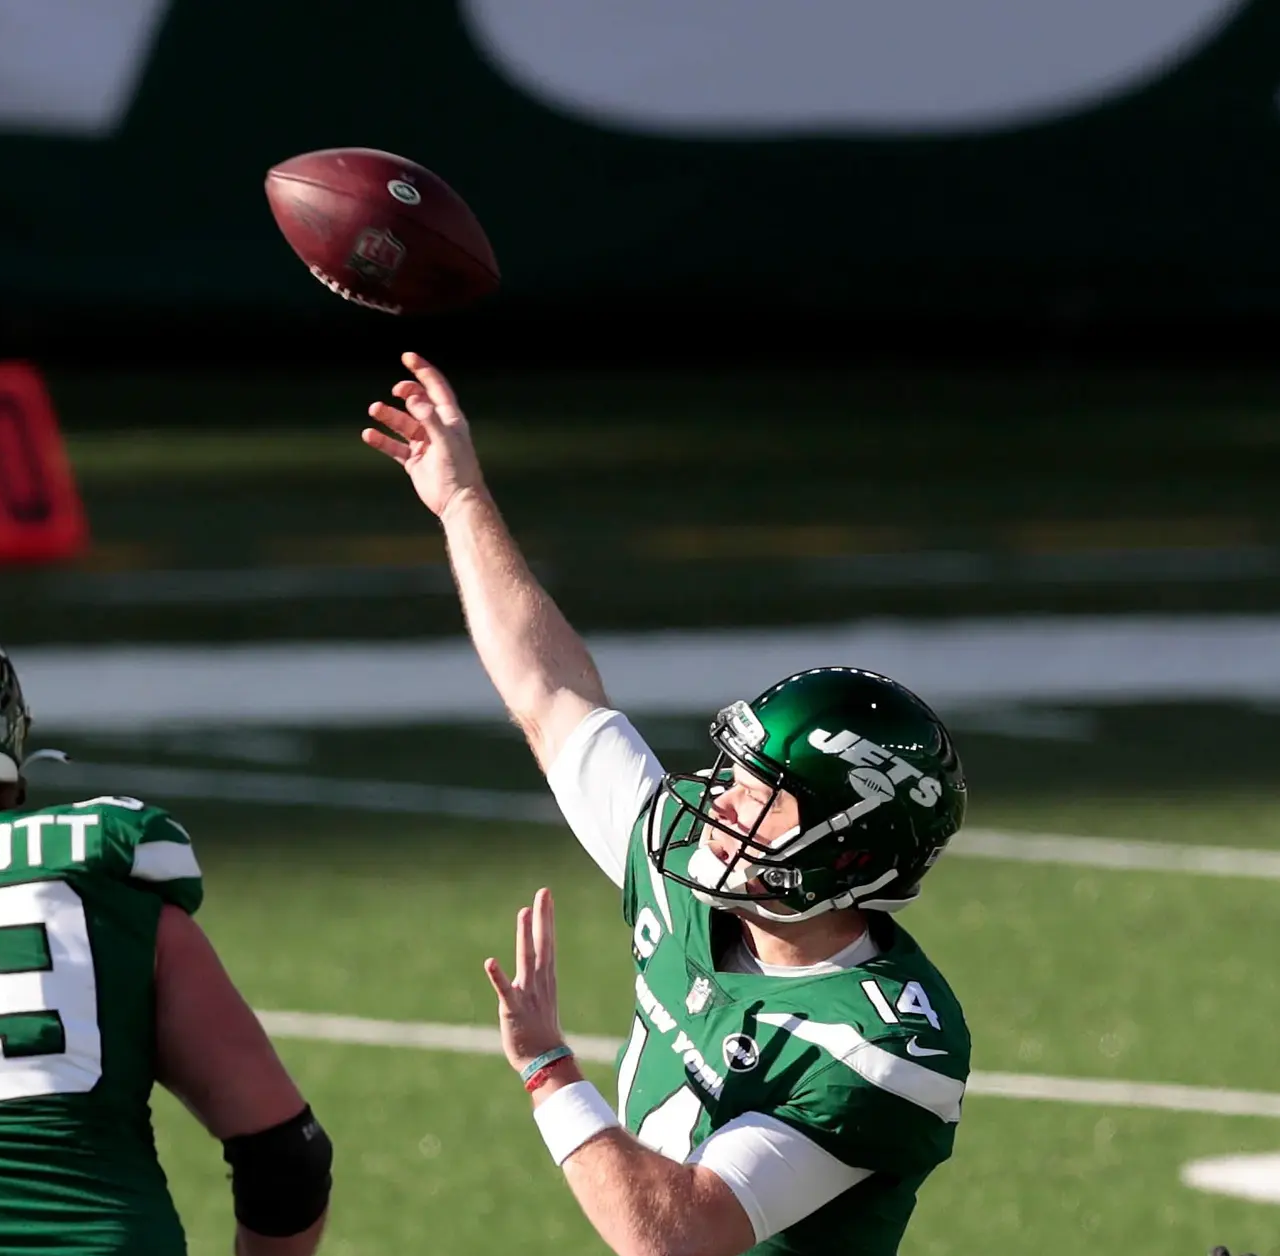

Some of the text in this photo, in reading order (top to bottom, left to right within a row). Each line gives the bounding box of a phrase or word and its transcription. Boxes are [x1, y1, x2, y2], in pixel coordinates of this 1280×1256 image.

[808, 728, 942, 808] JETS
[634, 907, 662, 958] C
[635, 973, 677, 1034] NEW
[671, 1030, 724, 1101] YORK
[860, 980, 941, 1031] 14
